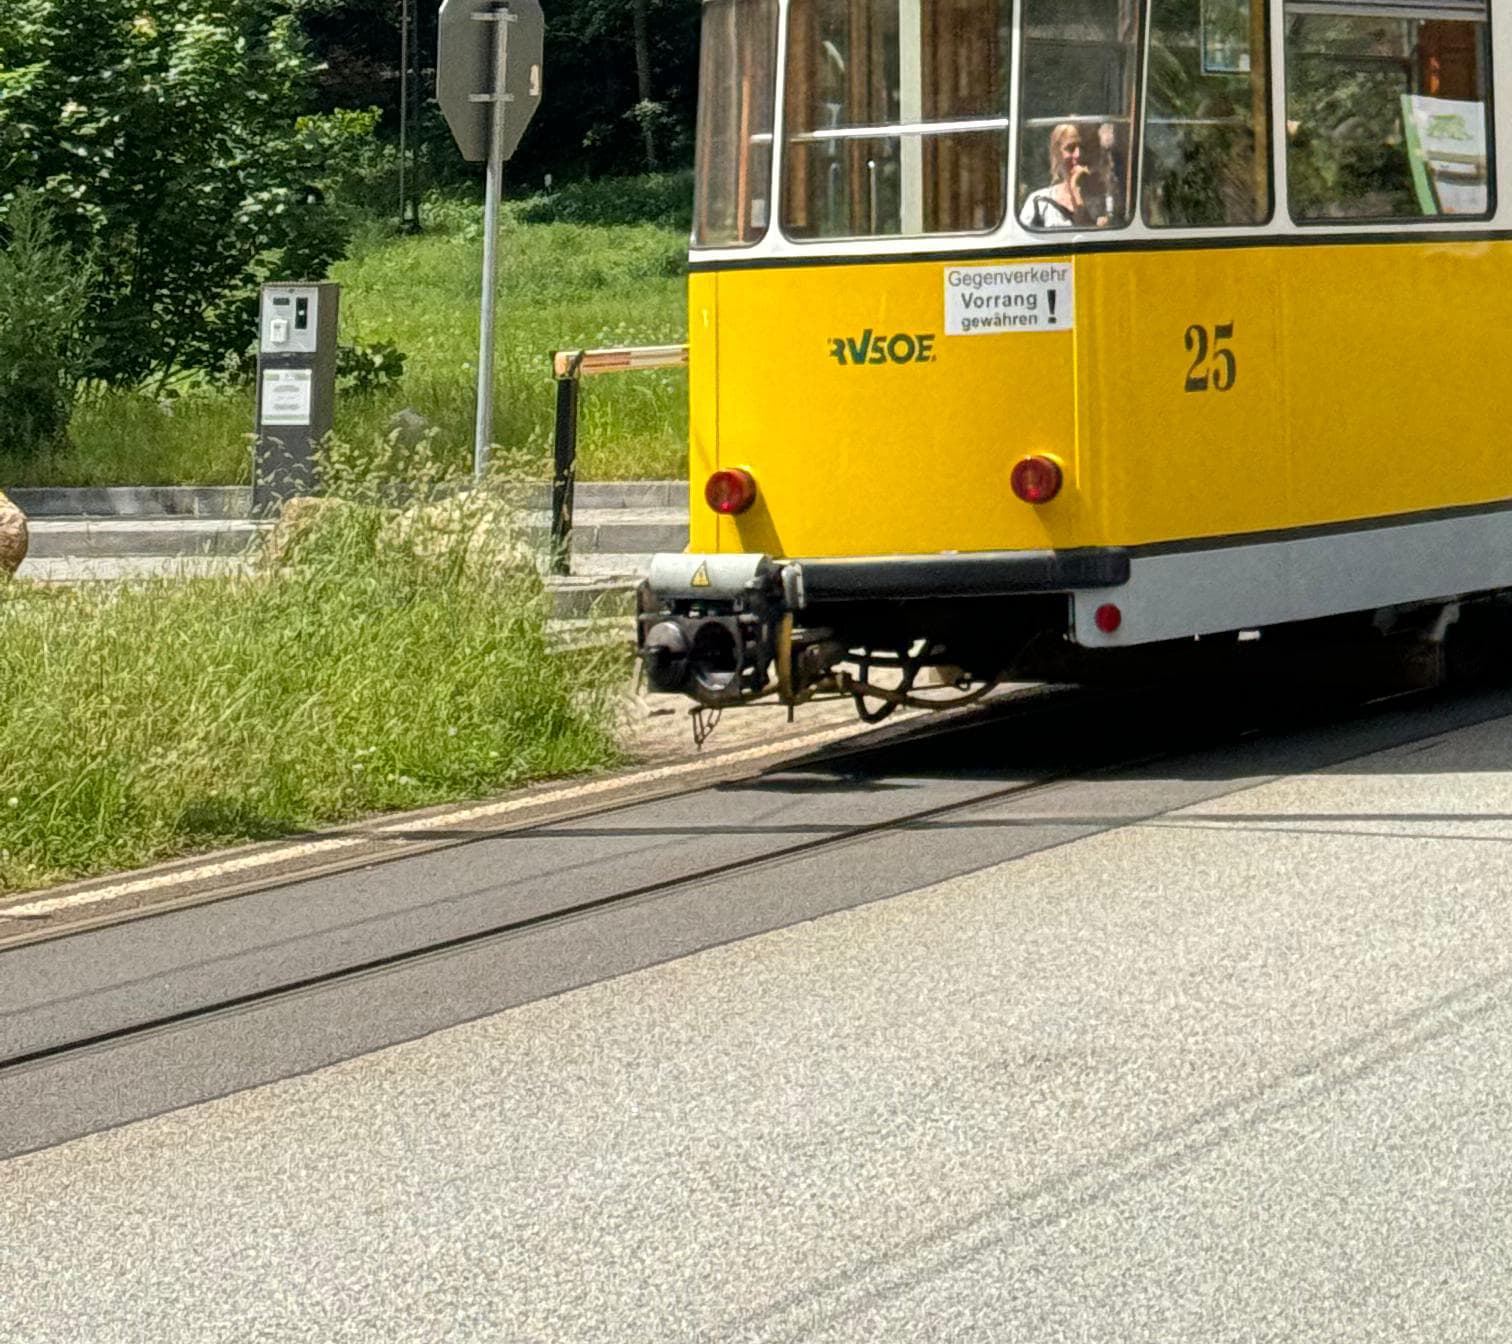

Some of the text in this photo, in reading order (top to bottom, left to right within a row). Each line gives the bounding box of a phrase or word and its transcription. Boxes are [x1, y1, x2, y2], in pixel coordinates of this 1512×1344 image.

[947, 266, 1068, 290] Gegenverkehr
[961, 292, 1037, 310] Vorrang
[960, 312, 1038, 331] gewähren
[1184, 320, 1237, 393] 25
